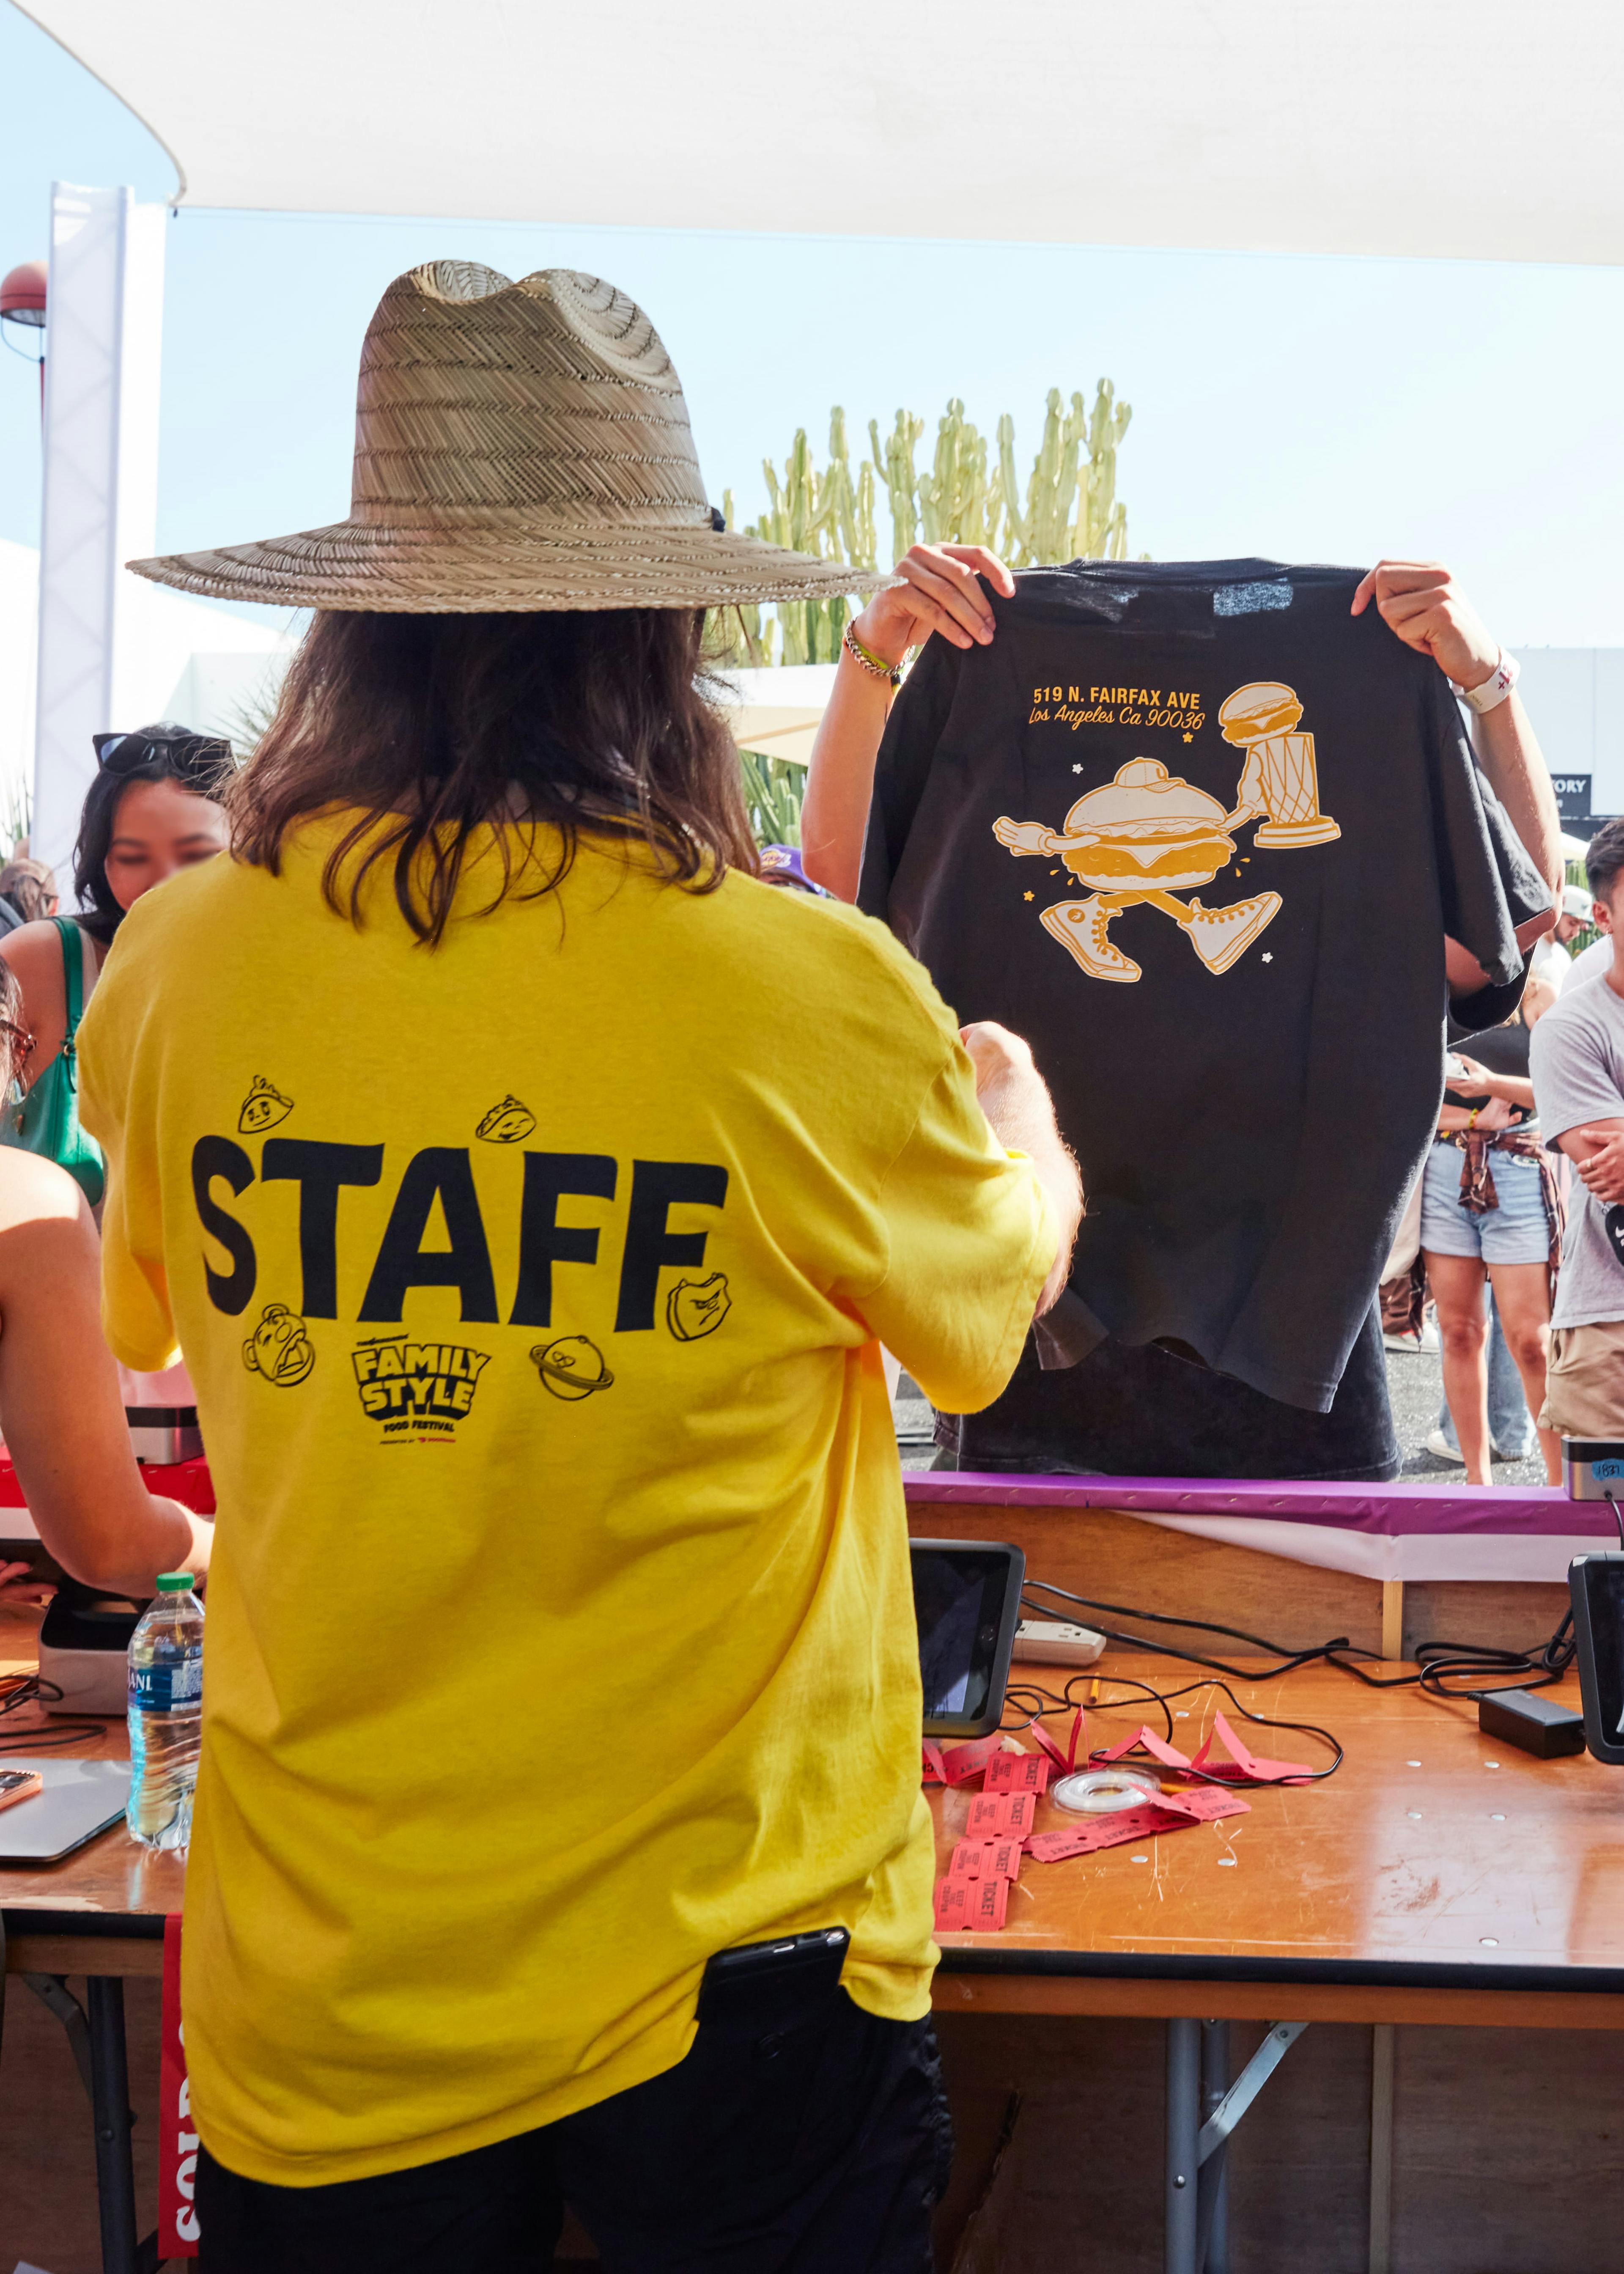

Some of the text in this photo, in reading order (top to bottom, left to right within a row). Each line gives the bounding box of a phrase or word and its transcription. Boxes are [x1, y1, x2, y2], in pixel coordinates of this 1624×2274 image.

[1034, 686, 1200, 709] 519 N. FAIRFAX AVE
[1029, 704, 1206, 731] Los Angeles Ca 90036
[1552, 779, 1587, 793] ORY
[192, 1134, 729, 1332] STAFF
[352, 1344, 492, 1383] FAMILY
[359, 1376, 476, 1419] STYLE
[384, 1420, 455, 1433] FOOD FESTIVAL
[1025, 1758, 1040, 1785] TICKET
[1010, 1796, 1026, 1825] TICKET
[995, 1846, 1011, 1872] TICKET
[981, 1881, 997, 1916] TICKET
